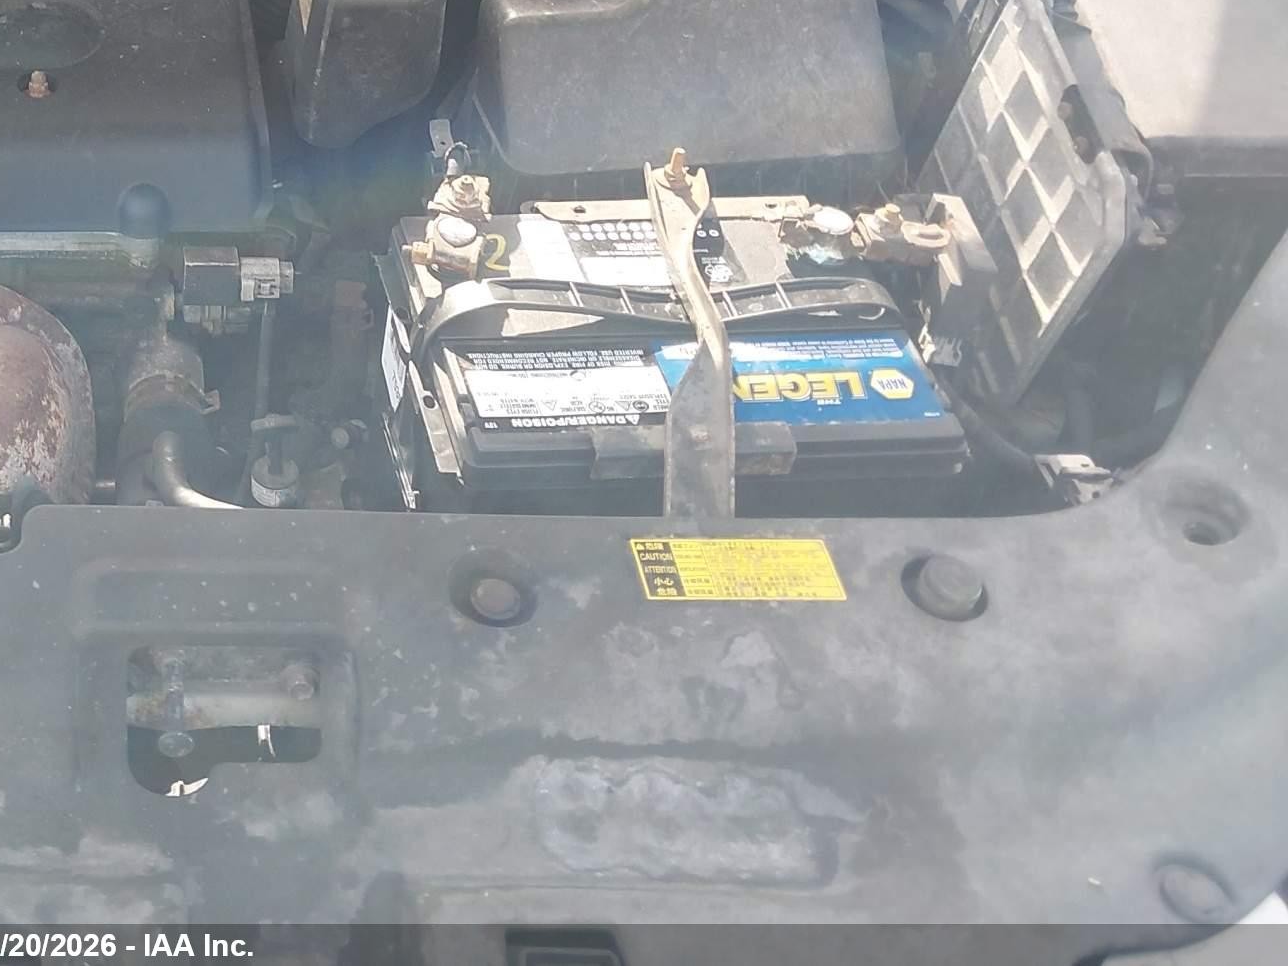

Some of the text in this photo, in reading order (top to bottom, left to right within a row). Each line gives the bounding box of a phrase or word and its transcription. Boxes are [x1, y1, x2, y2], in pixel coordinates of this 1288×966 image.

[483, 233, 510, 271] 2
[877, 378, 907, 390] NAPA
[511, 414, 626, 427] DANGER/POISON
[645, 566, 677, 574] ATTENTION
